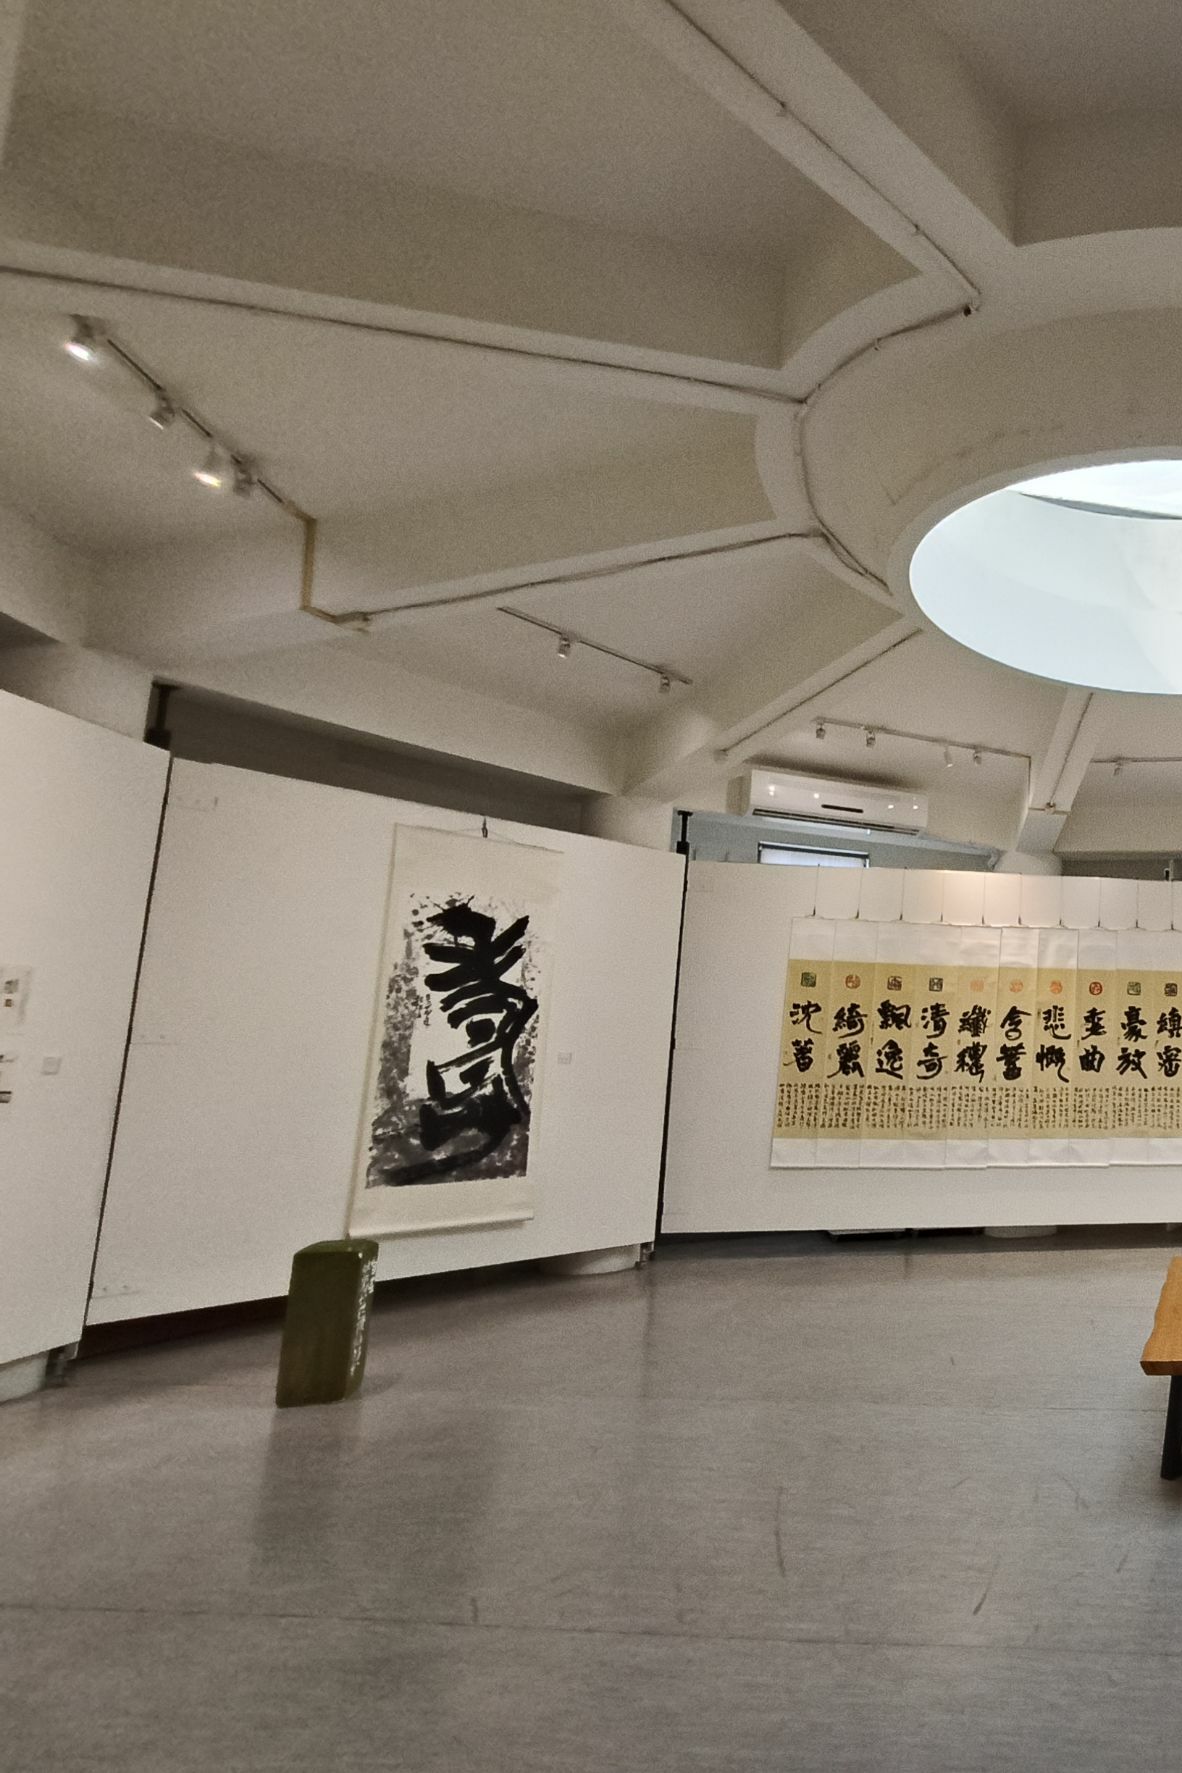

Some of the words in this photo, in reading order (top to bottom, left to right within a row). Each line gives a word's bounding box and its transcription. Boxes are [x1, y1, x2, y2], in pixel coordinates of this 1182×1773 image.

[826, 1002, 868, 1079] 綺麗
[916, 1002, 950, 1081] 清奇
[1115, 1005, 1148, 1080] 豪放
